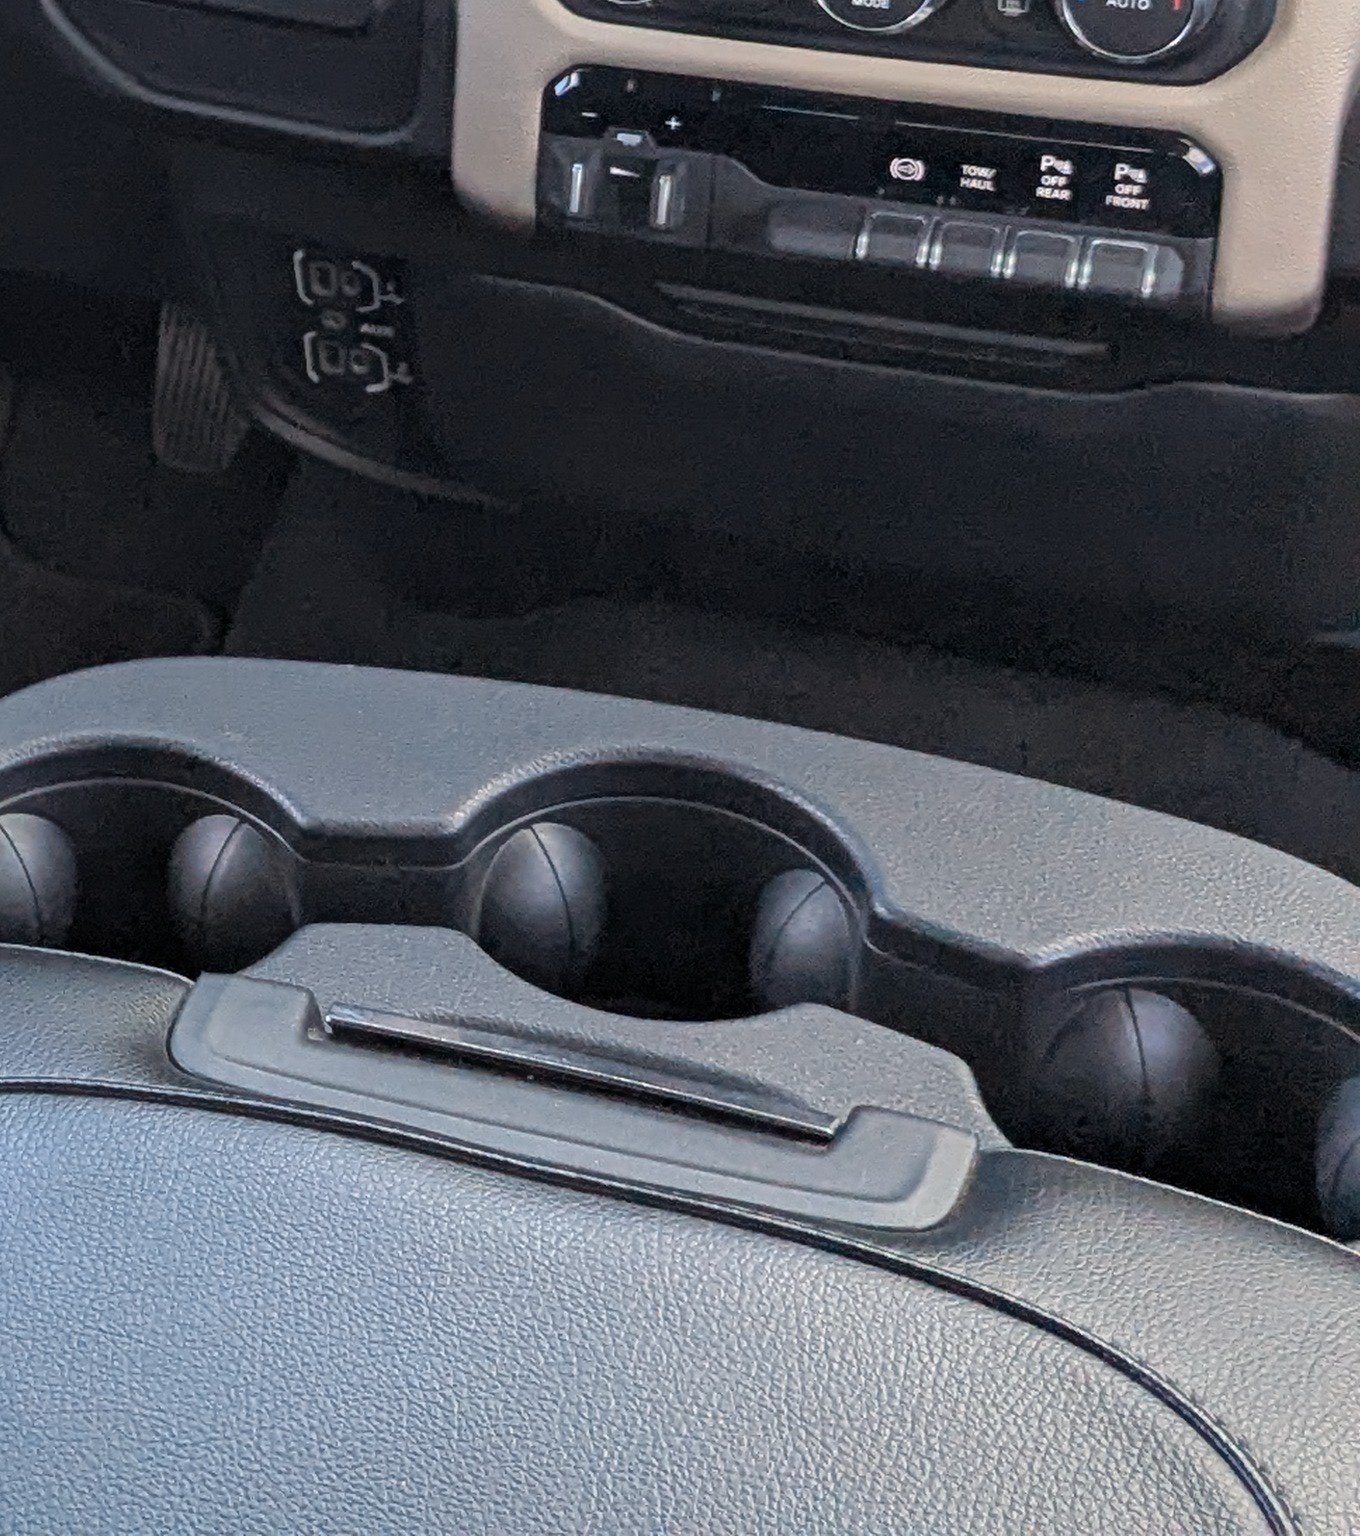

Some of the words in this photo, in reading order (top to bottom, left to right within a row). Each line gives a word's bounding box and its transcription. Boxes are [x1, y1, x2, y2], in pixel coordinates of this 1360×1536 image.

[959, 177, 996, 191] HAUL
[1040, 175, 1068, 187] OFF
[1035, 186, 1072, 201] REAR
[1114, 184, 1143, 196] OFF
[1106, 195, 1150, 210] FRONT
